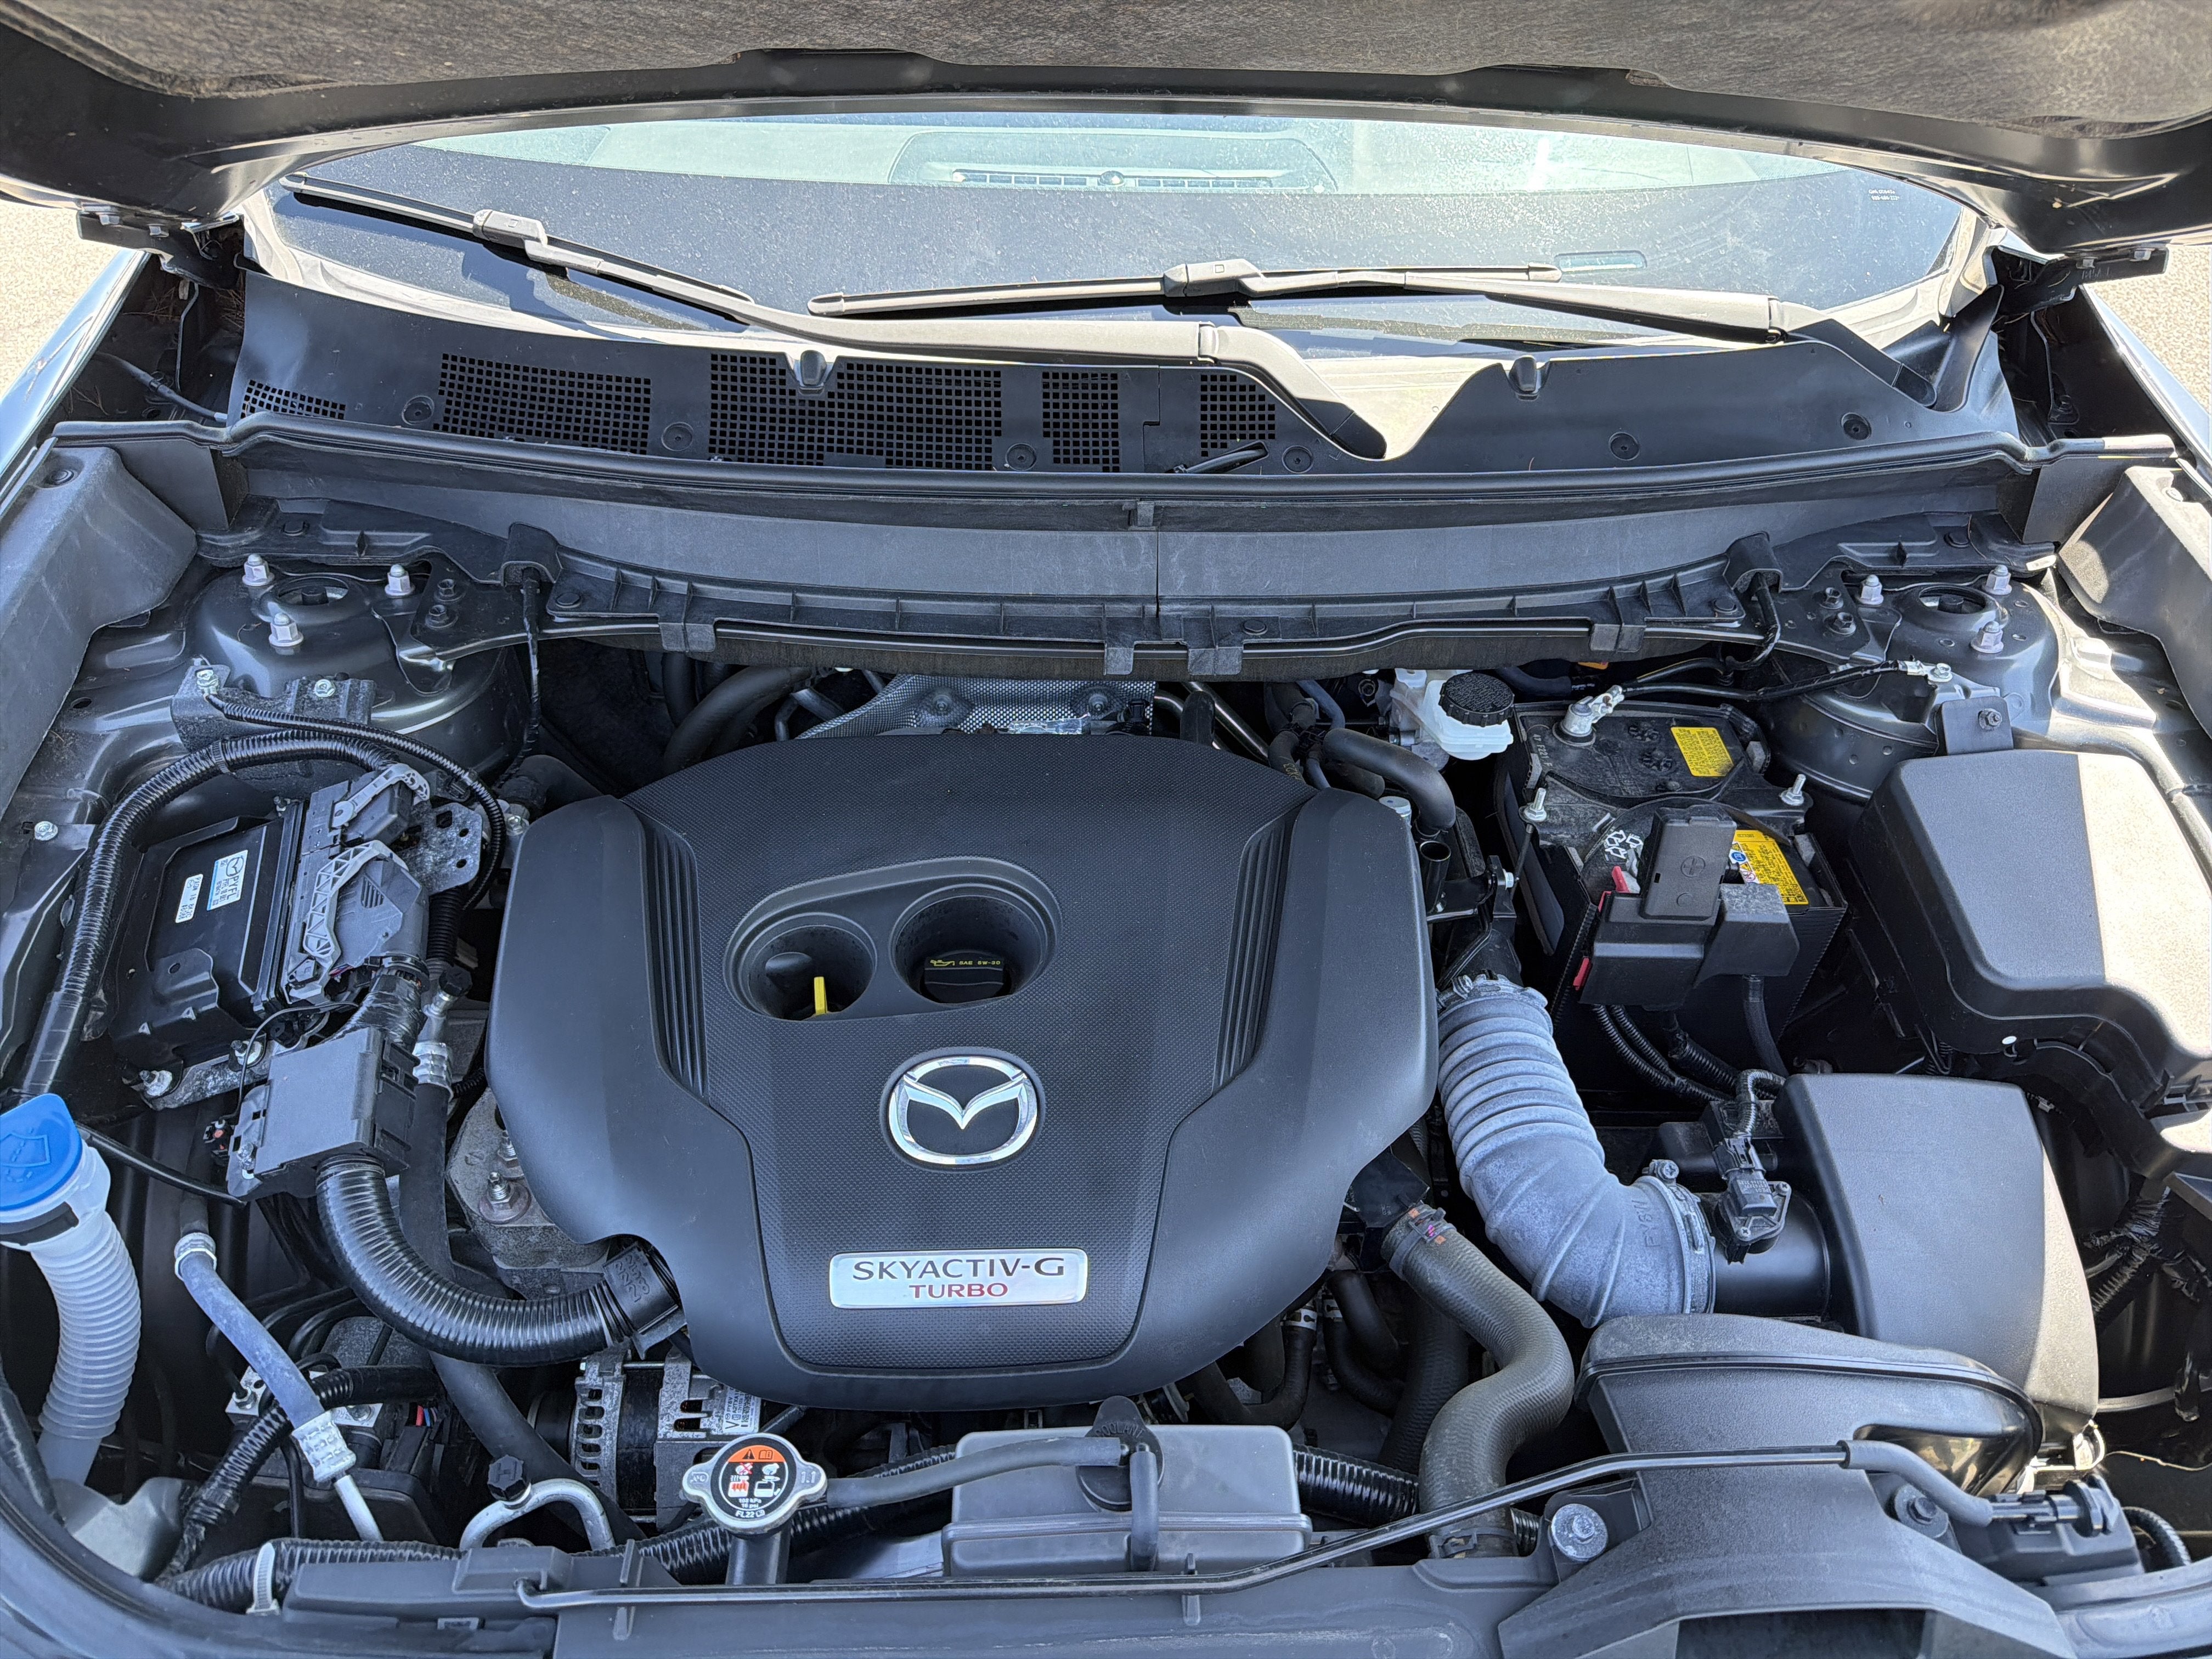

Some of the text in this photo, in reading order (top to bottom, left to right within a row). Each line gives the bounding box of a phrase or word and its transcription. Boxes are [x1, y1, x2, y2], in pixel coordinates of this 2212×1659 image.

[226, 875, 239, 900] PYFL
[853, 1257, 1065, 1281] SKYACTIV-G
[909, 1283, 1008, 1299] TURBO
[1095, 1421, 1146, 1438] COOLANT
[801, 1471, 816, 1483] 1.1
[736, 1510, 755, 1519] FL22
